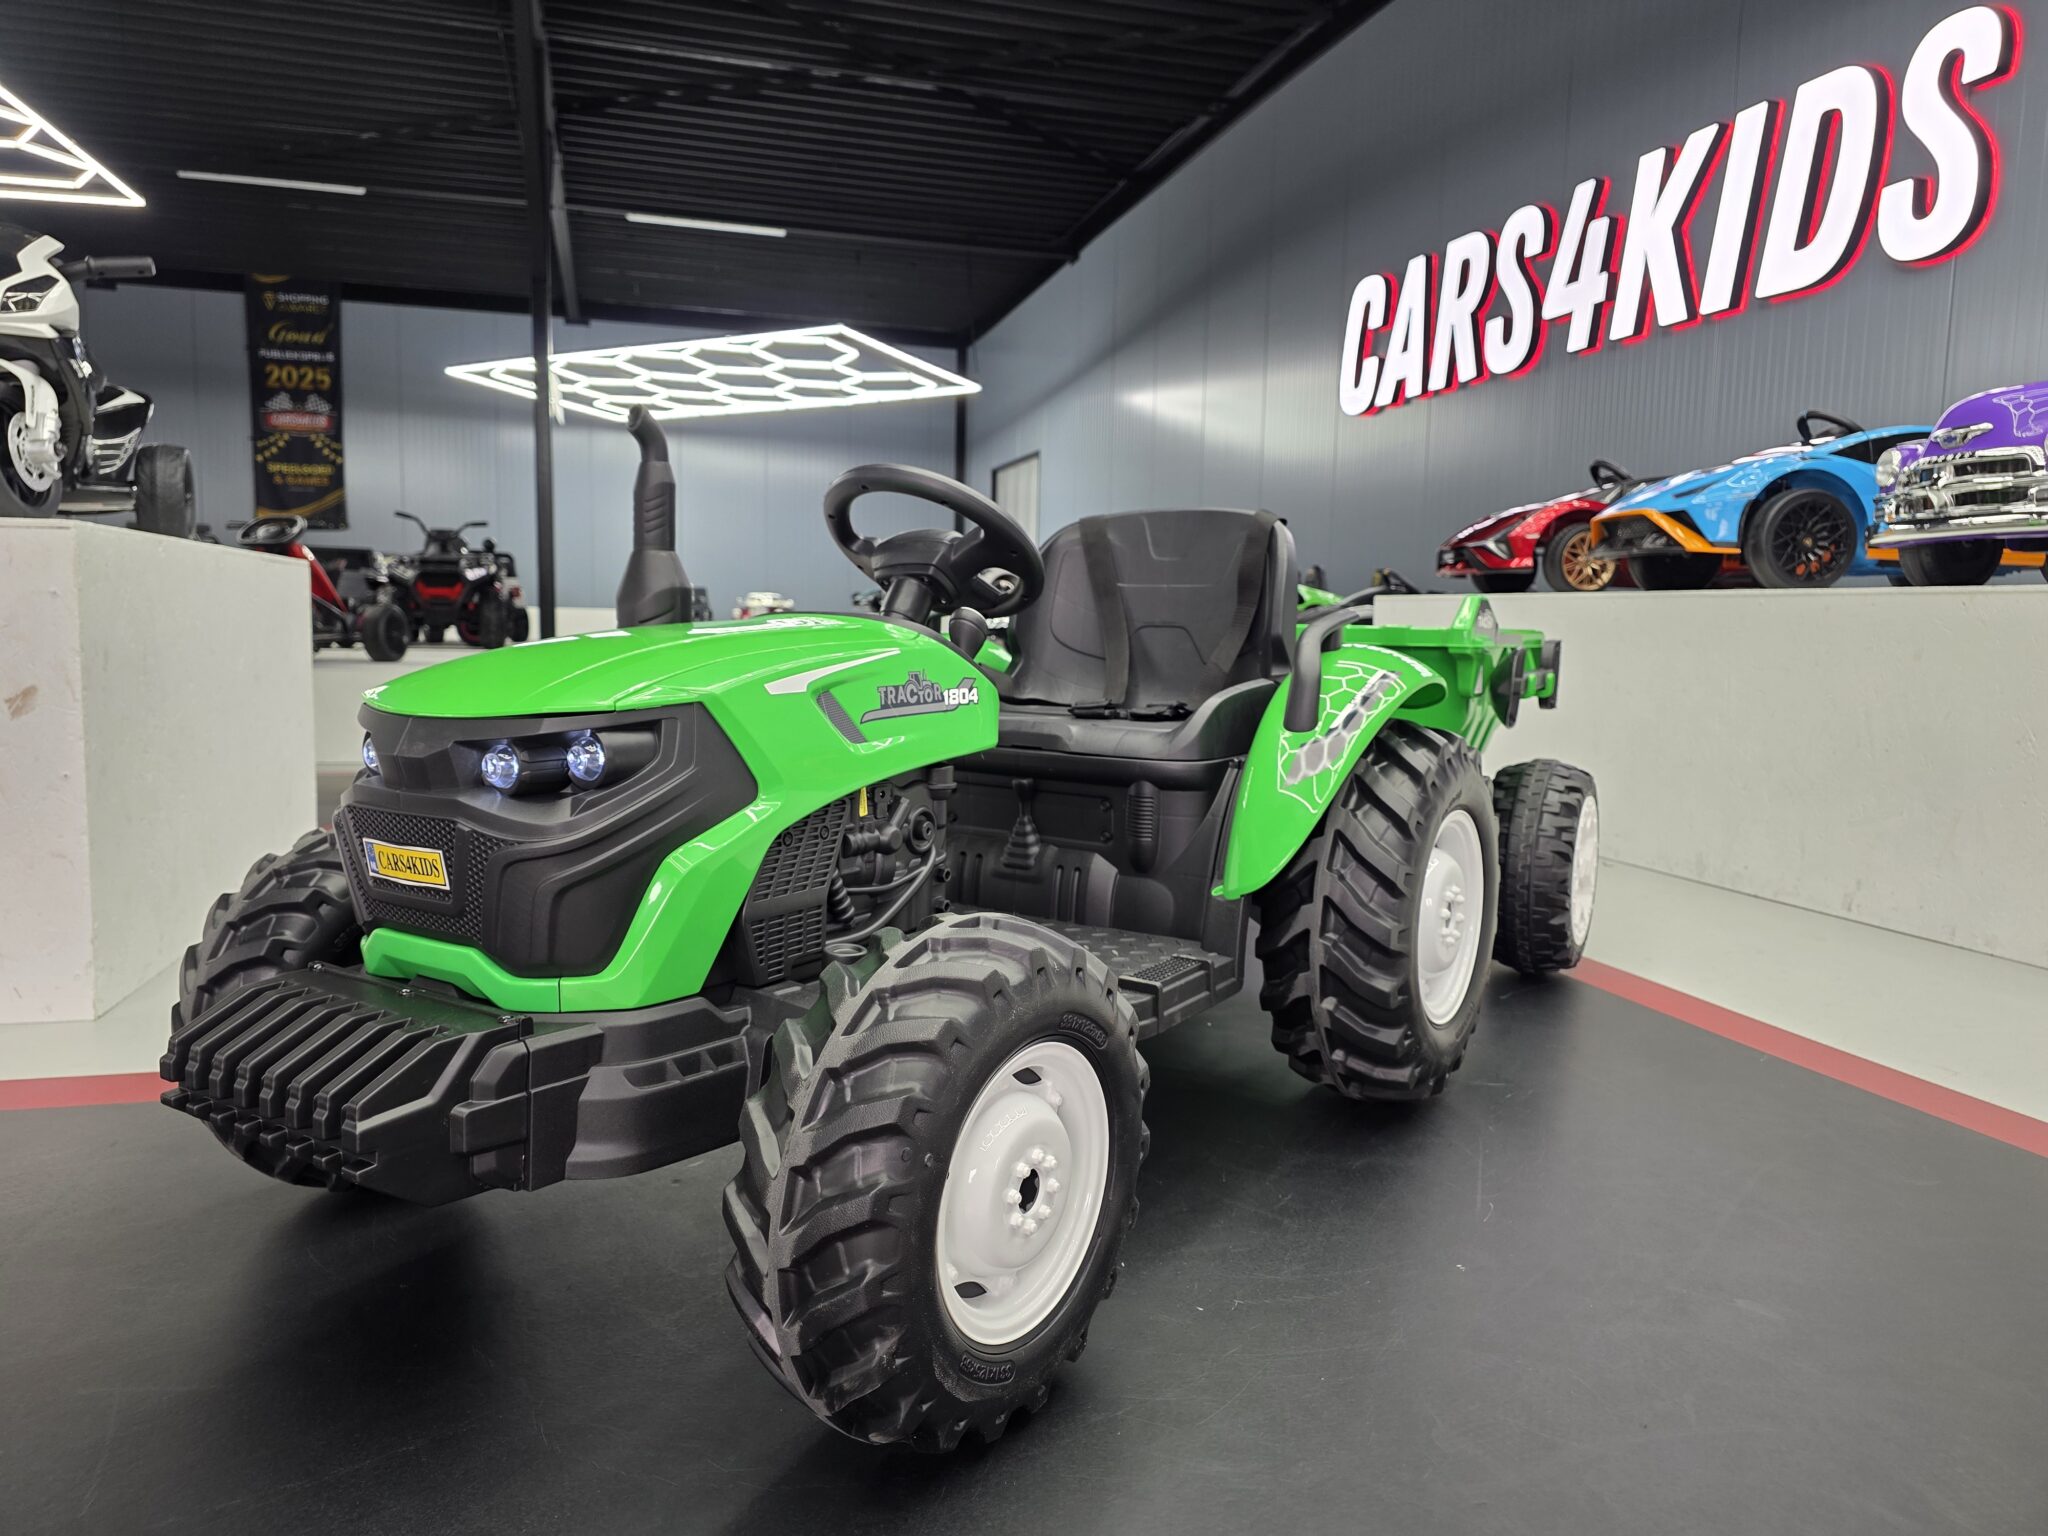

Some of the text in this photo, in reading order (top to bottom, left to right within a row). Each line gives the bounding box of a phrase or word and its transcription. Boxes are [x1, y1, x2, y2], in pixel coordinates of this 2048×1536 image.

[1339, 4, 2005, 416] CARS4KIDS
[264, 363, 332, 391] 2025
[878, 682, 979, 706] TRACTOR 1804
[377, 850, 441, 878] CARS4KIDS
